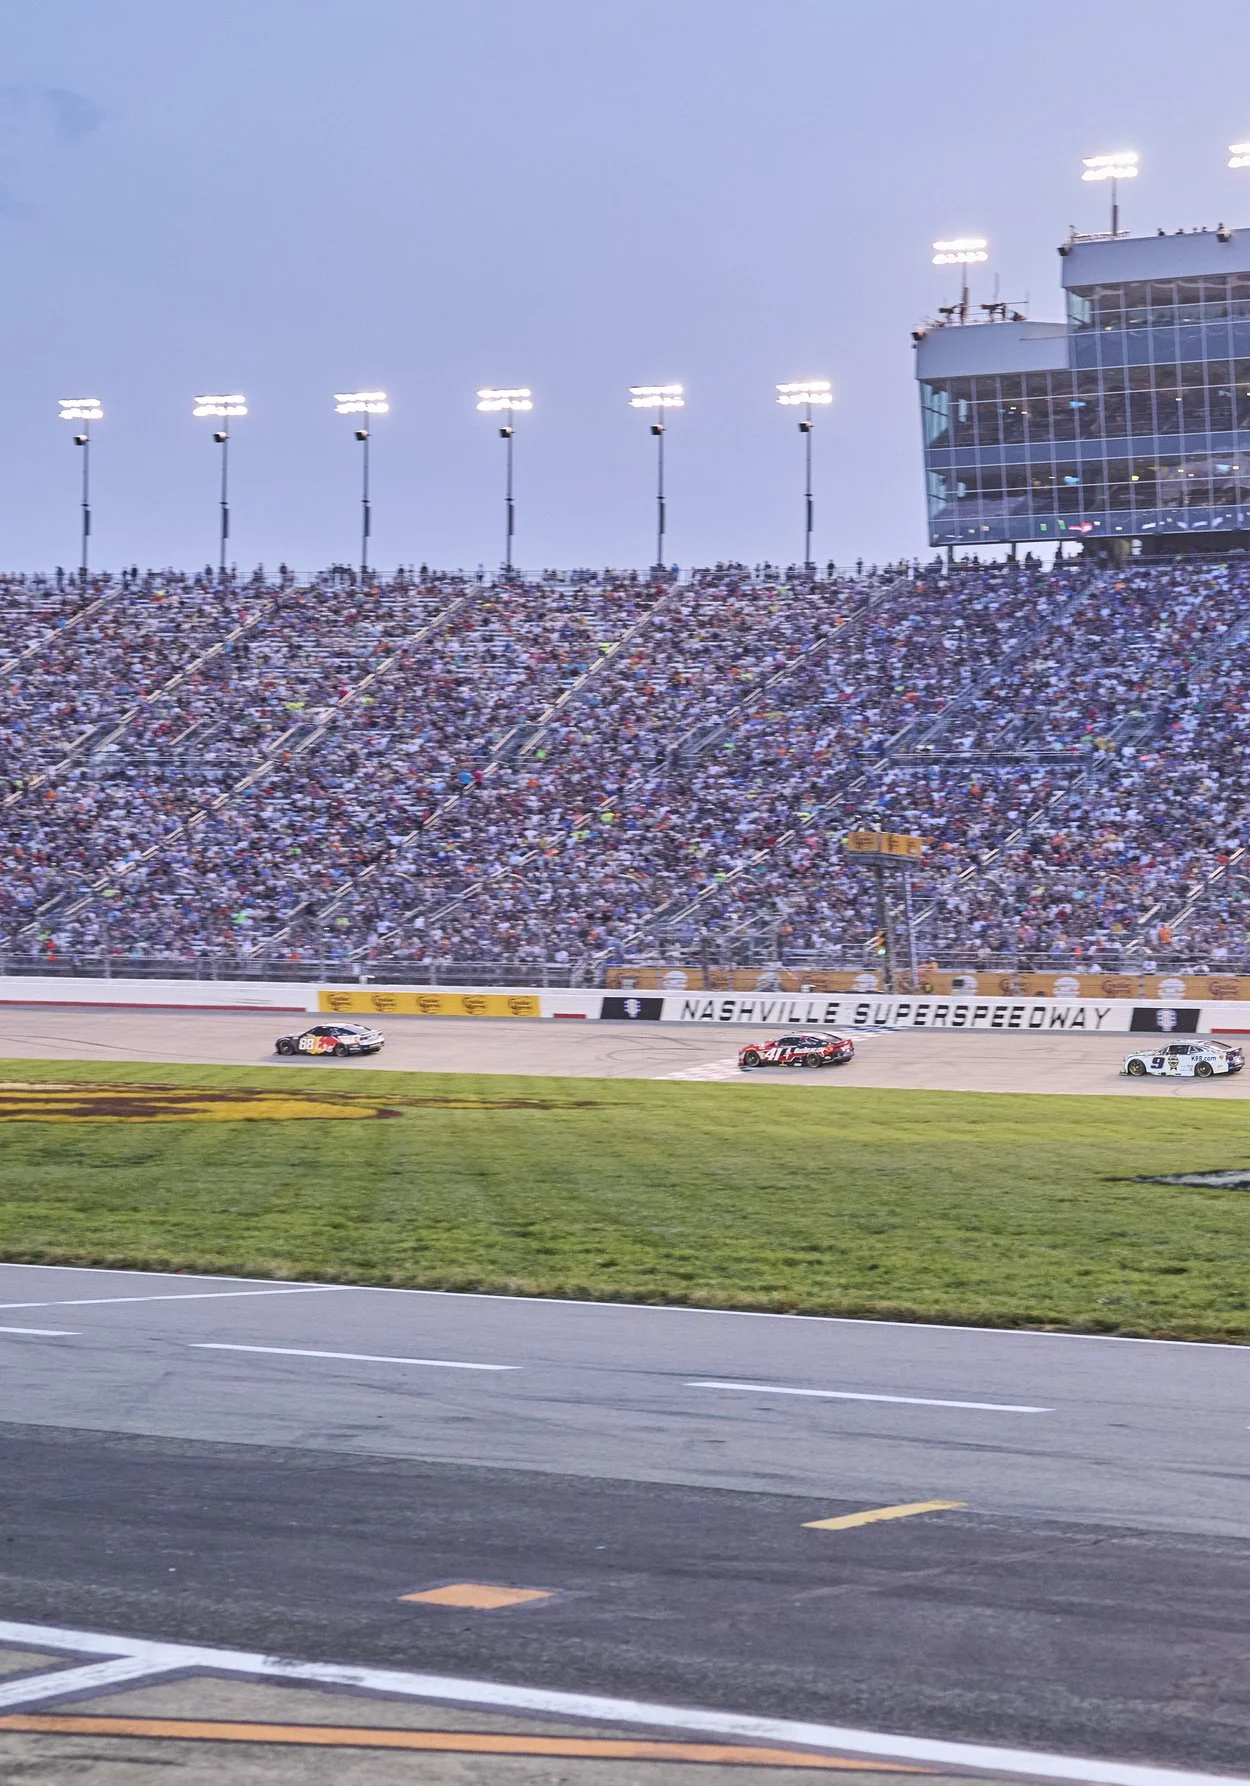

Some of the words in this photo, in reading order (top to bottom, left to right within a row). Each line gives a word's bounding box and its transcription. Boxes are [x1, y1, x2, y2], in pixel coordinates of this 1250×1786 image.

[681, 1000, 839, 1023] NASHVILLE
[853, 1003, 1112, 1029] SUPERSPEEDWAY
[298, 1038, 314, 1050] 88
[765, 1048, 782, 1061] 41
[1150, 1057, 1165, 1069] 9
